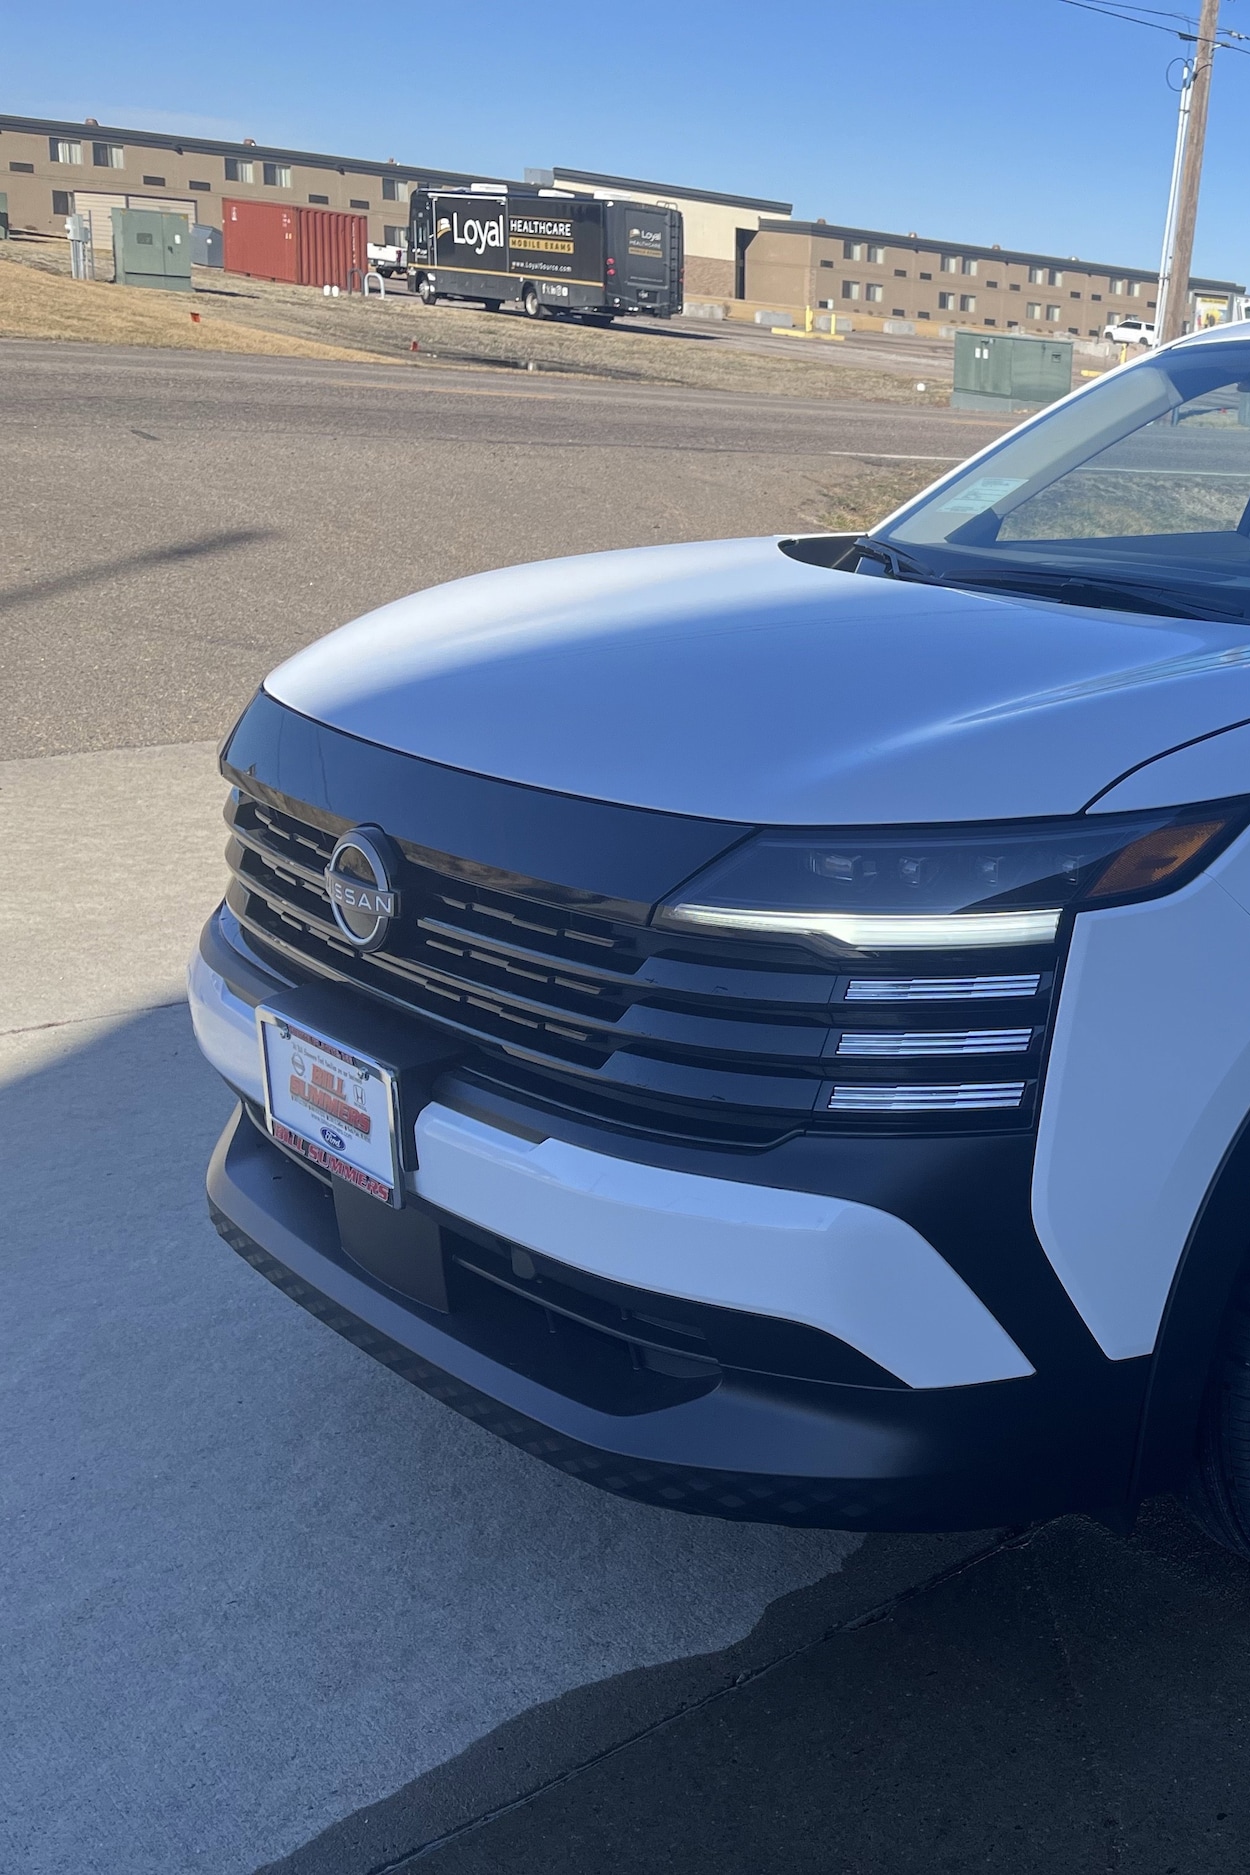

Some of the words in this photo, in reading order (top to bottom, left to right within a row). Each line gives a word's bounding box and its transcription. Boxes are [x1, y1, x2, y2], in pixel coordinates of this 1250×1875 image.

[453, 212, 504, 255] Loyal
[510, 219, 571, 236] HEALTHCARE
[511, 239, 540, 249] MOBILE
[545, 242, 571, 251] EXAMS
[641, 230, 661, 241] Loyal
[327, 875, 391, 914] SSAN
[312, 1063, 346, 1100] BILL
[290, 1074, 371, 1134] SUMMERS
[273, 1121, 305, 1156] BILL
[308, 1143, 389, 1202] SUMMERS
